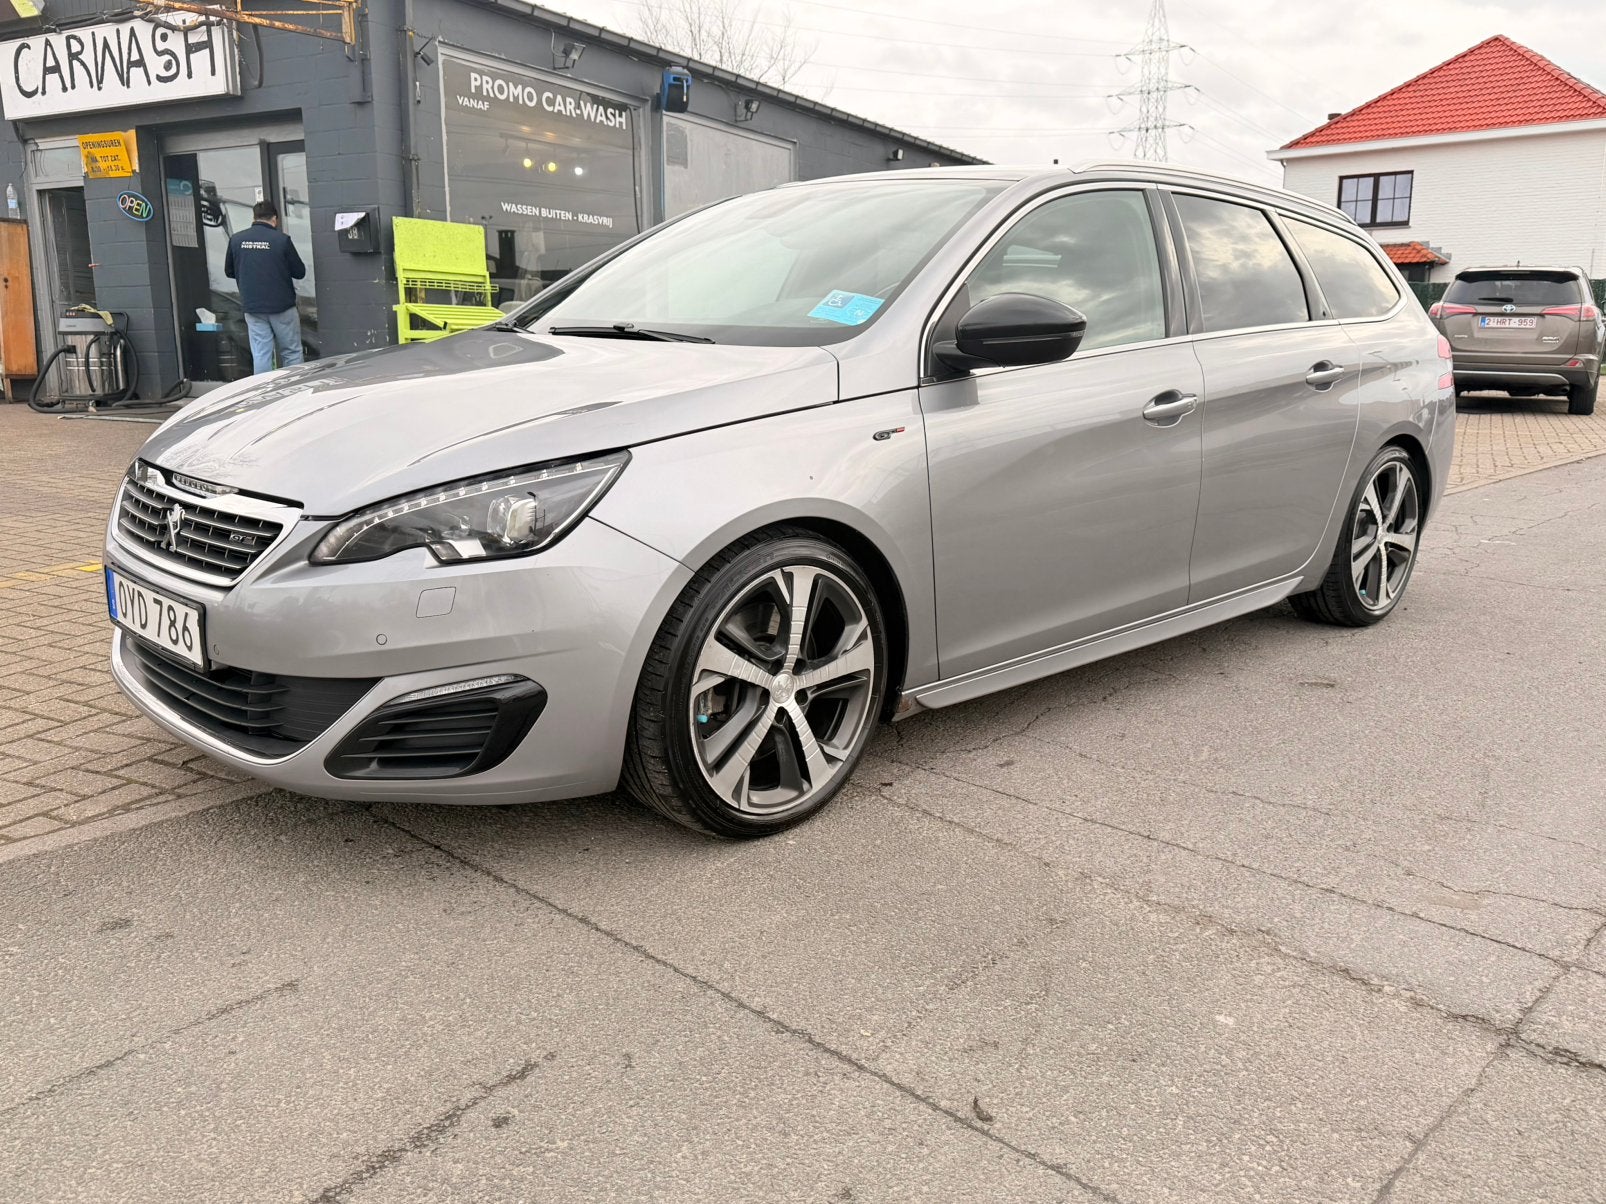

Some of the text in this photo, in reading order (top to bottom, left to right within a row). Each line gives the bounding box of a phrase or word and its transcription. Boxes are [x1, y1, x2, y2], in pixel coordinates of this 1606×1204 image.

[14, 14, 216, 98] CARWASH
[456, 95, 490, 111] VANAF
[470, 72, 626, 129] PROMO CAR-WASH
[82, 139, 121, 149] OPENINGSUREN
[119, 194, 150, 218] OPEN
[501, 201, 540, 216] WASSEN
[541, 207, 572, 221] BUITEN
[578, 213, 613, 228] KRASVRIJ
[118, 580, 193, 652] OYD 786
